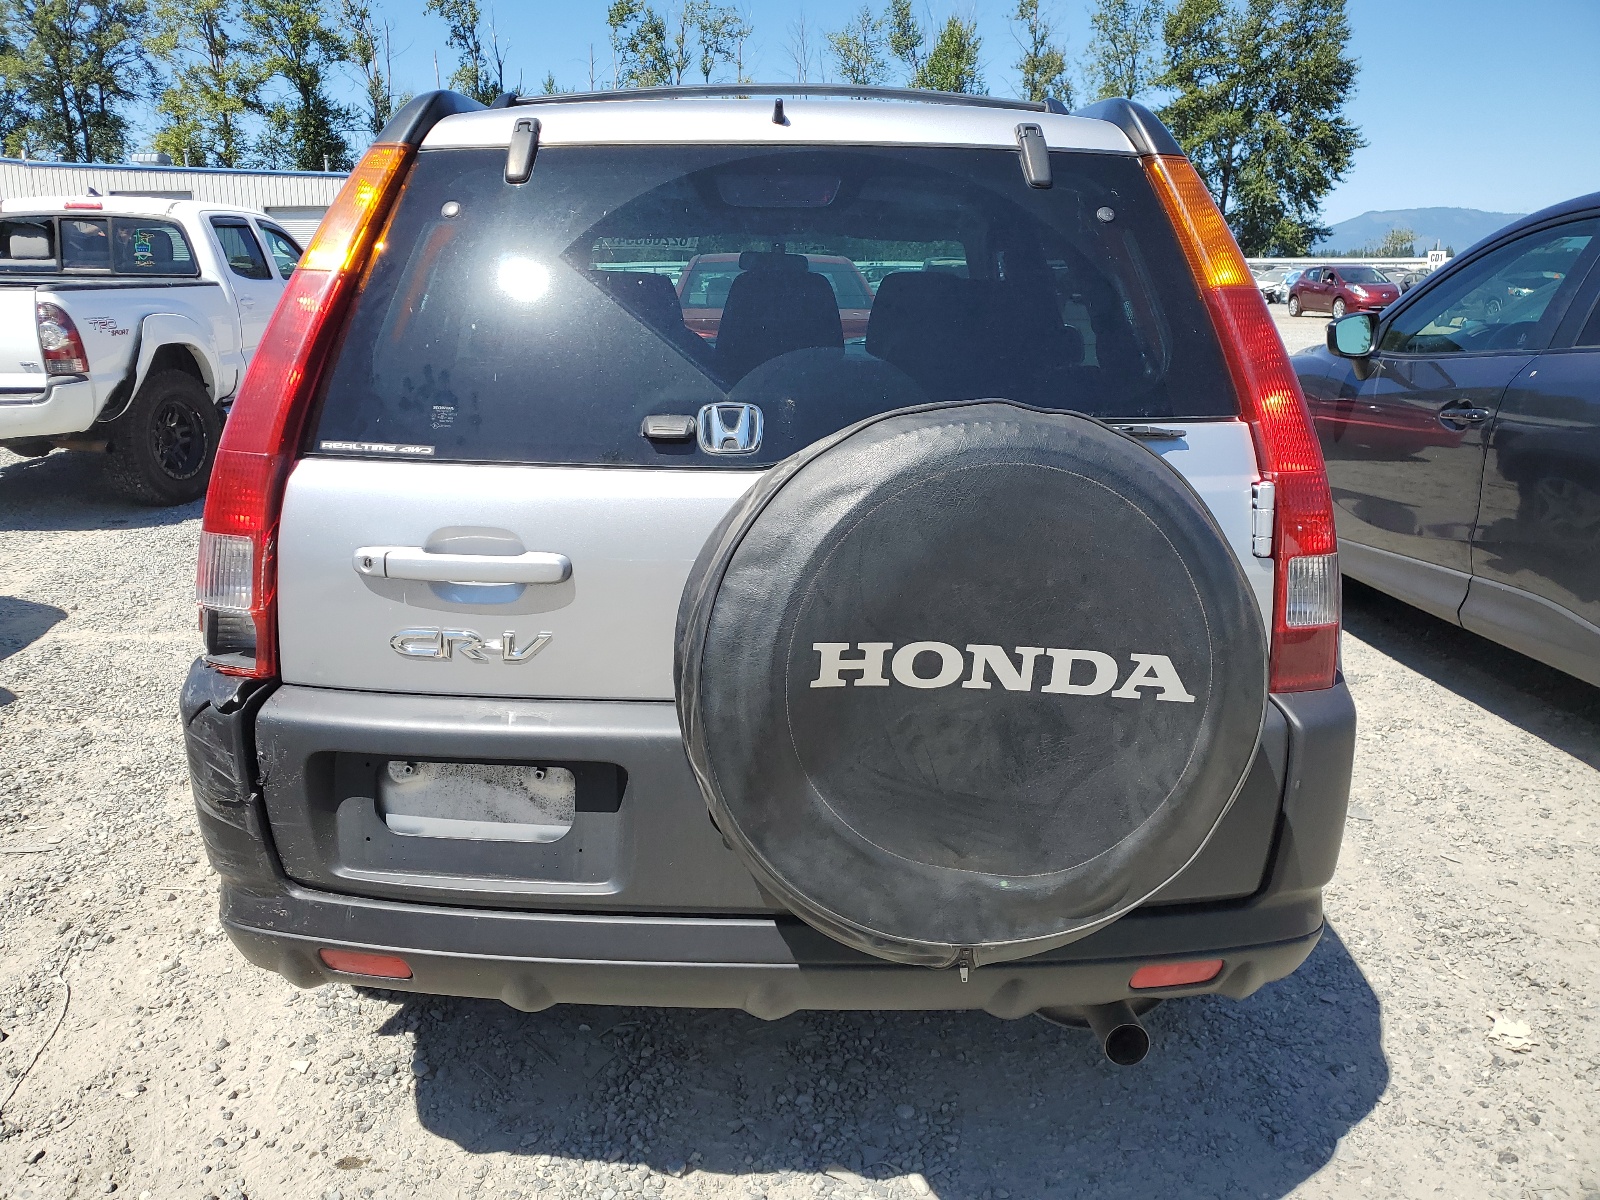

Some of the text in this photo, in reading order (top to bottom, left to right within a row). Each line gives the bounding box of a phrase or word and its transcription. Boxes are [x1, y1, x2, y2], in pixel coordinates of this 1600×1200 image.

[1430, 253, 1443, 262] CD1
[398, 446, 432, 454] 4WD
[389, 626, 553, 663] CR-V
[809, 640, 1196, 703] HONDA
